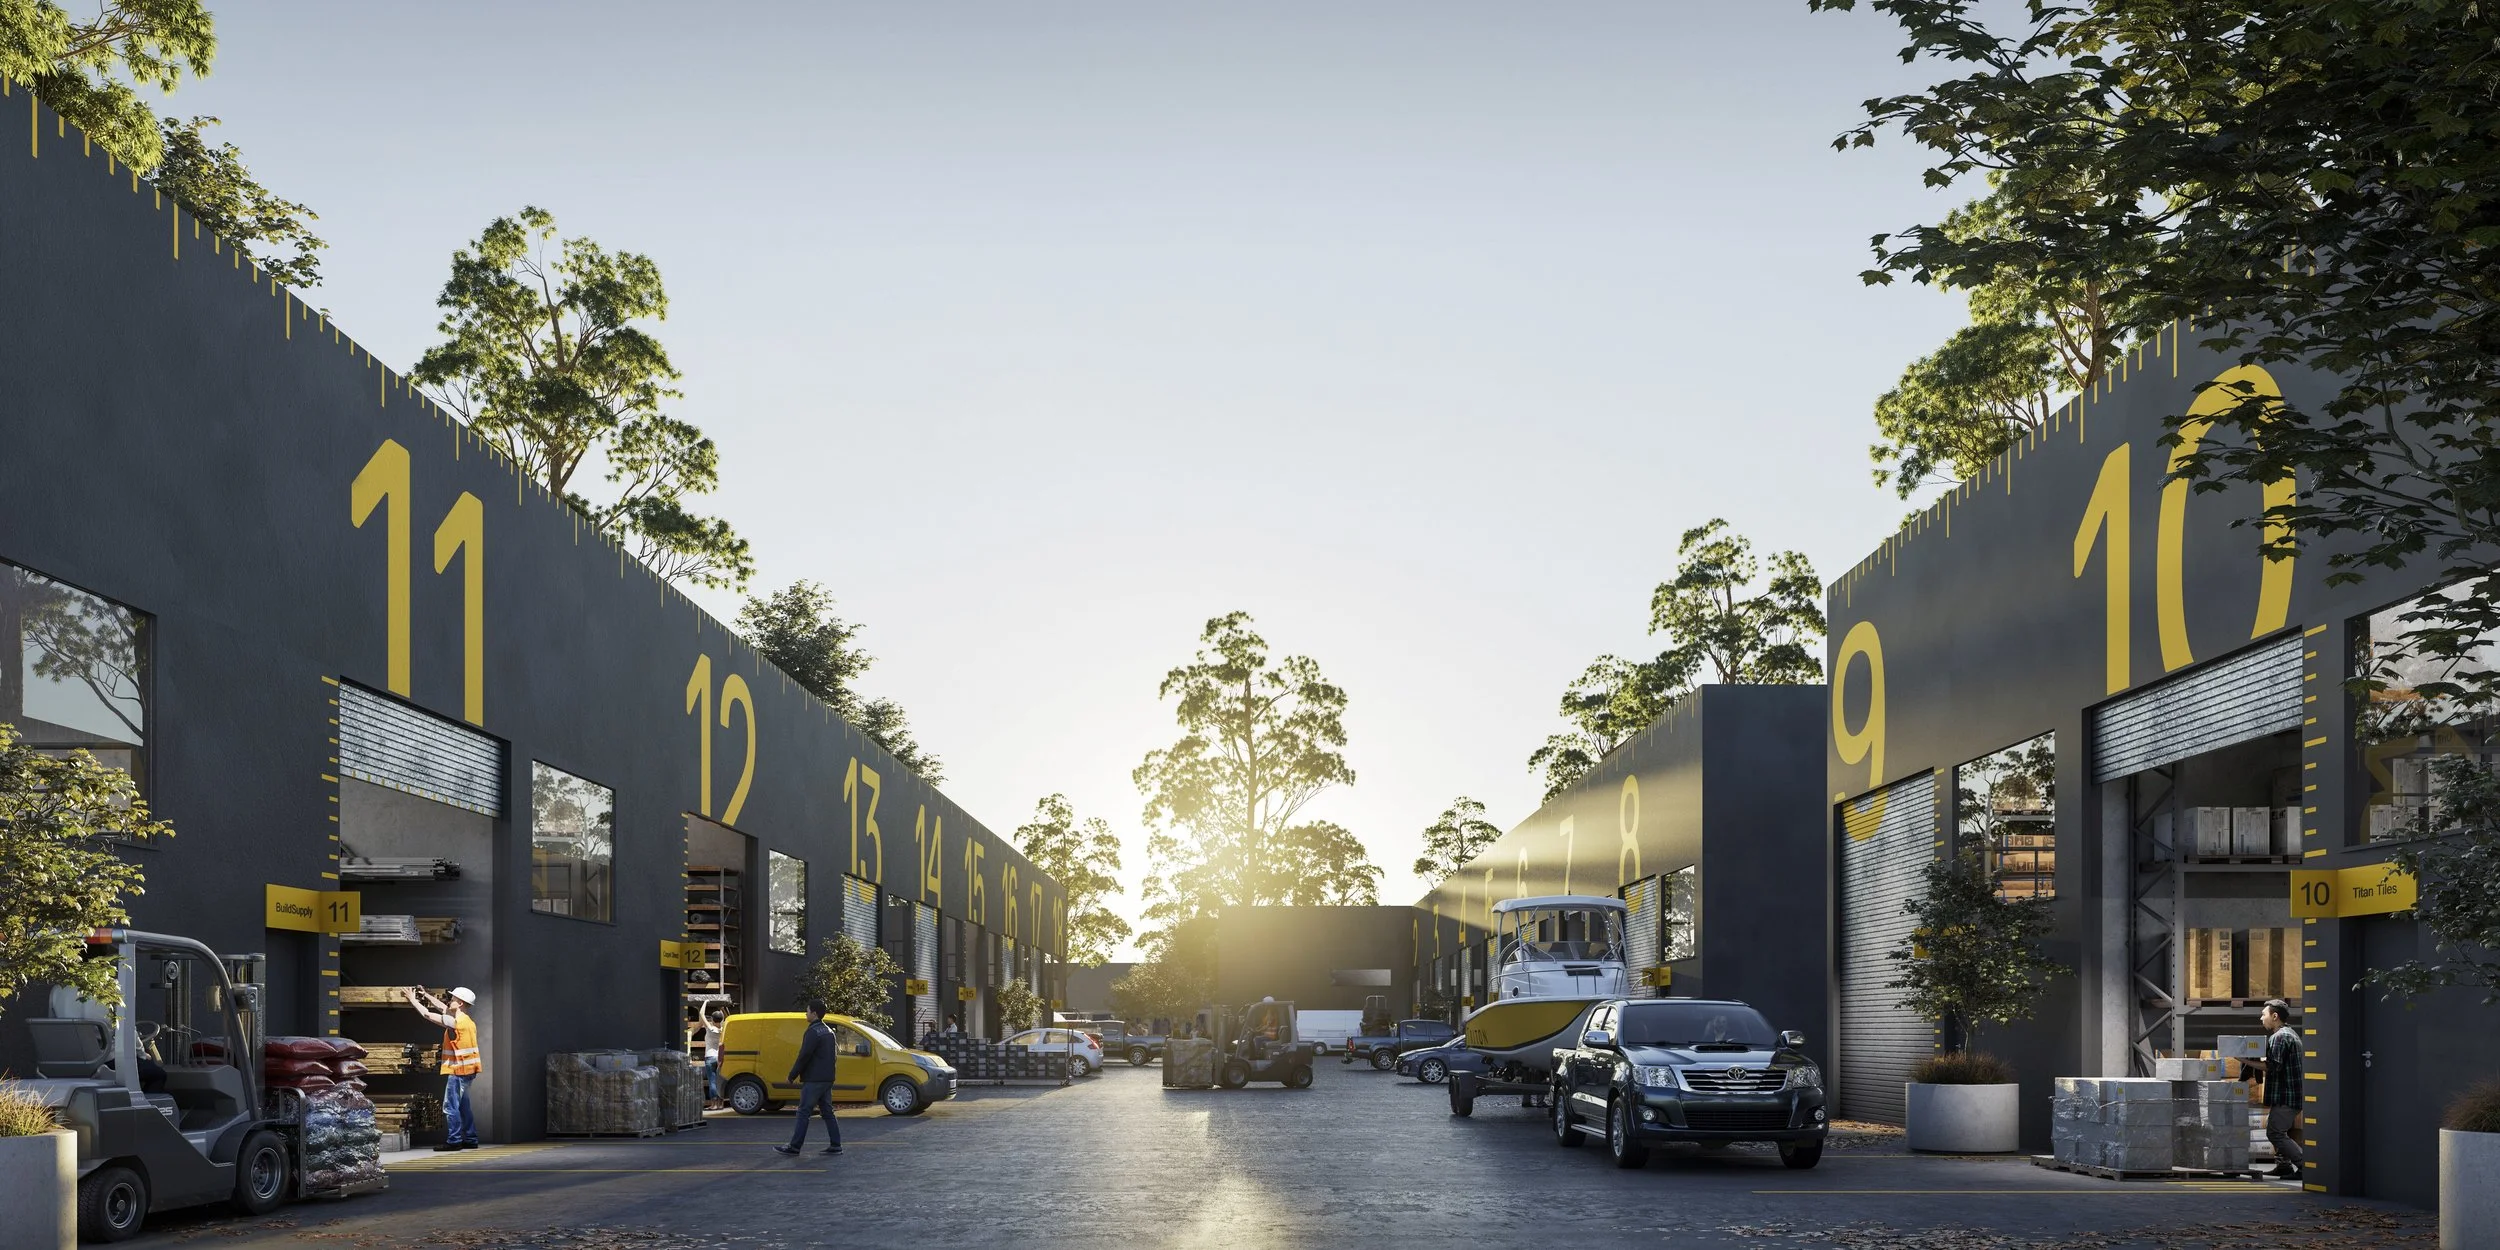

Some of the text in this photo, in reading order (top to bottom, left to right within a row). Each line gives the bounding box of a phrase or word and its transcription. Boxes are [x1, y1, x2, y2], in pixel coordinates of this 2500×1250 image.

[2073, 364, 2296, 696] 10
[351, 438, 483, 727] 11
[686, 653, 756, 827] 12
[1832, 620, 1889, 842] 9
[843, 756, 882, 905] 13
[914, 803, 942, 928] 14
[1559, 814, 1574, 897] 7
[1618, 774, 1646, 915] 8
[275, 901, 348, 923] BuildSupply 11
[964, 837, 985, 926] 15
[1002, 862, 1018, 951] 16
[1030, 880, 1042, 958] 17
[1458, 885, 1470, 963] 4
[2300, 881, 2398, 906] 10 Titan Tiles
[684, 949, 701, 963] 12
[916, 983, 926, 992] 14
[966, 990, 974, 998] 15
